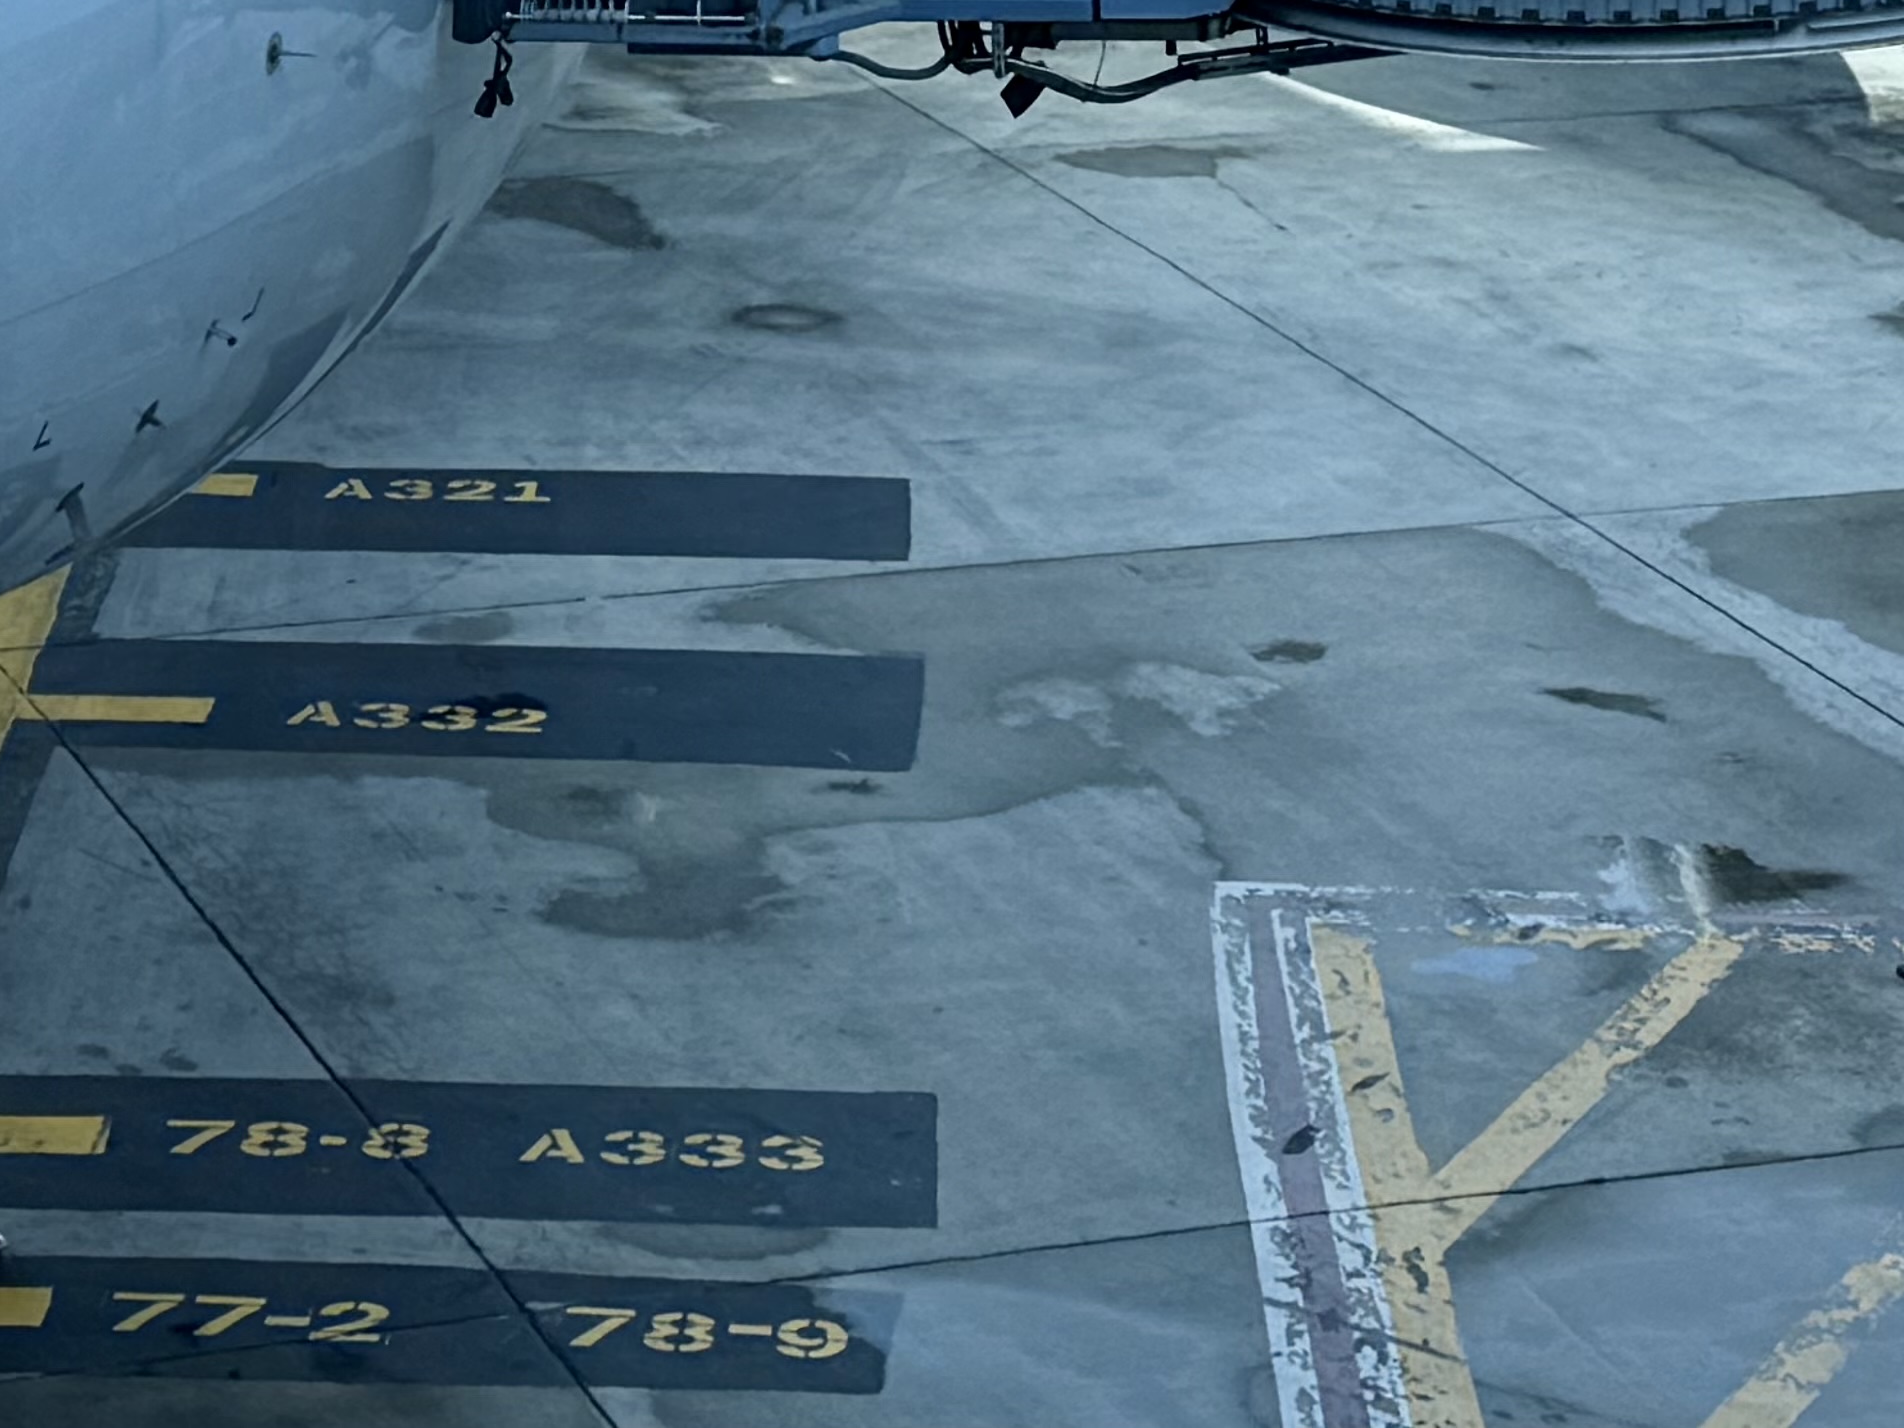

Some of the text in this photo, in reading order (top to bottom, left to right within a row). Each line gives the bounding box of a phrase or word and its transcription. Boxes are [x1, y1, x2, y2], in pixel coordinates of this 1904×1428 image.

[324, 478, 551, 502] A321
[287, 701, 547, 732] A332
[167, 1120, 824, 1171] 78-8 A333
[112, 1292, 849, 1359] 77-2 78-9
